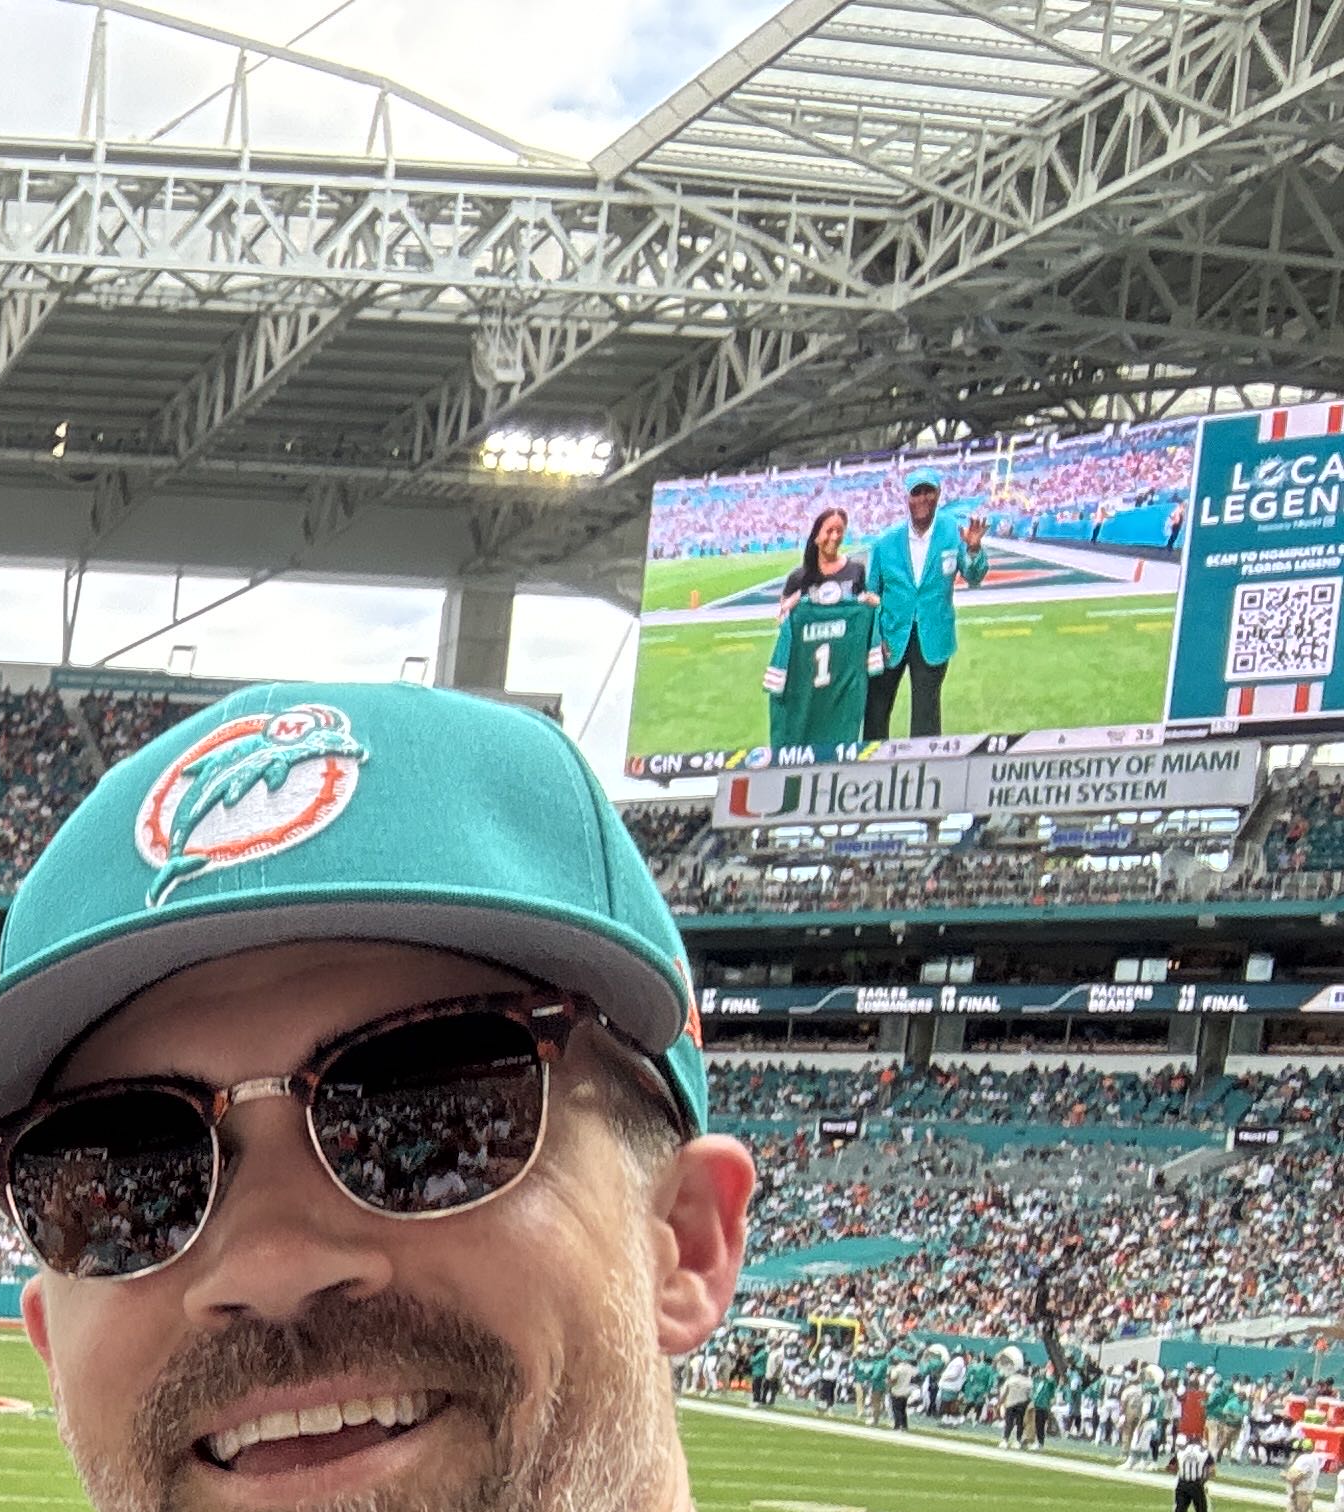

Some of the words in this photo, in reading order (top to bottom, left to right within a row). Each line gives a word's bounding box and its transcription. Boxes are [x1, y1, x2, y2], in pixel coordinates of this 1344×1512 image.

[1240, 551, 1258, 563] TO
[813, 643, 831, 689] 1
[274, 720, 308, 737] M
[650, 754, 682, 774] CIN
[704, 751, 725, 771] 24
[778, 744, 815, 767] MIA
[835, 742, 857, 763] 14
[991, 756, 1123, 783] UNIVERSITY
[1125, 754, 1159, 775] OF
[1162, 749, 1241, 774] MIAMI
[987, 784, 1072, 808] HEALTH
[1076, 780, 1168, 805] SYSTEM
[1090, 984, 1154, 1000] PACKERS
[721, 997, 760, 1014] FINAL
[959, 996, 1001, 1013] FINAL
[1202, 995, 1249, 1012] FINAL
